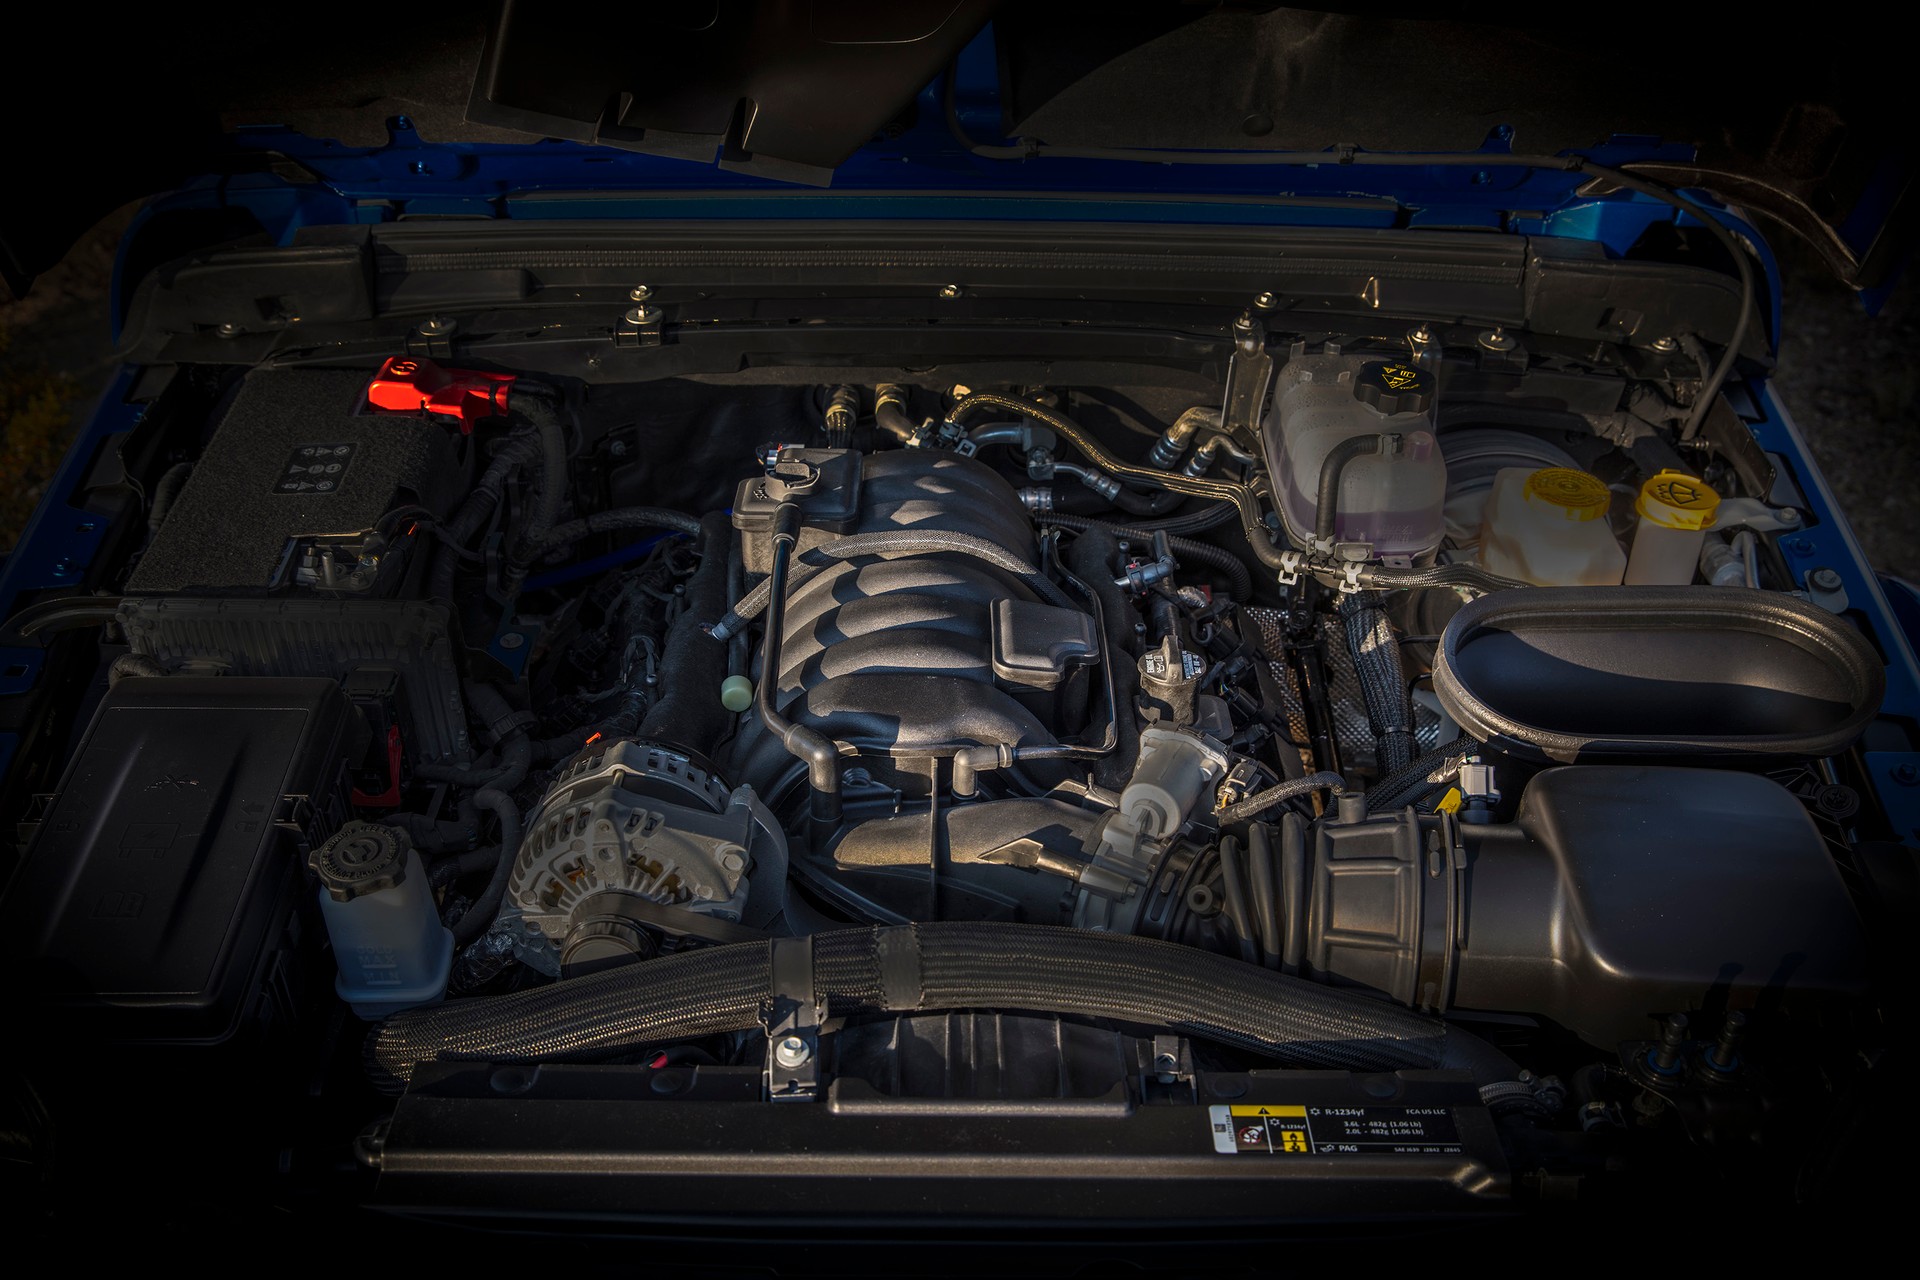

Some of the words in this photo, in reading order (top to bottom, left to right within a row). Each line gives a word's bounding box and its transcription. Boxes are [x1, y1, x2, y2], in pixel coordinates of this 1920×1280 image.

[358, 955, 396, 965] MAX
[363, 971, 400, 981] MIN
[1325, 1108, 1364, 1117] R-1234yf
